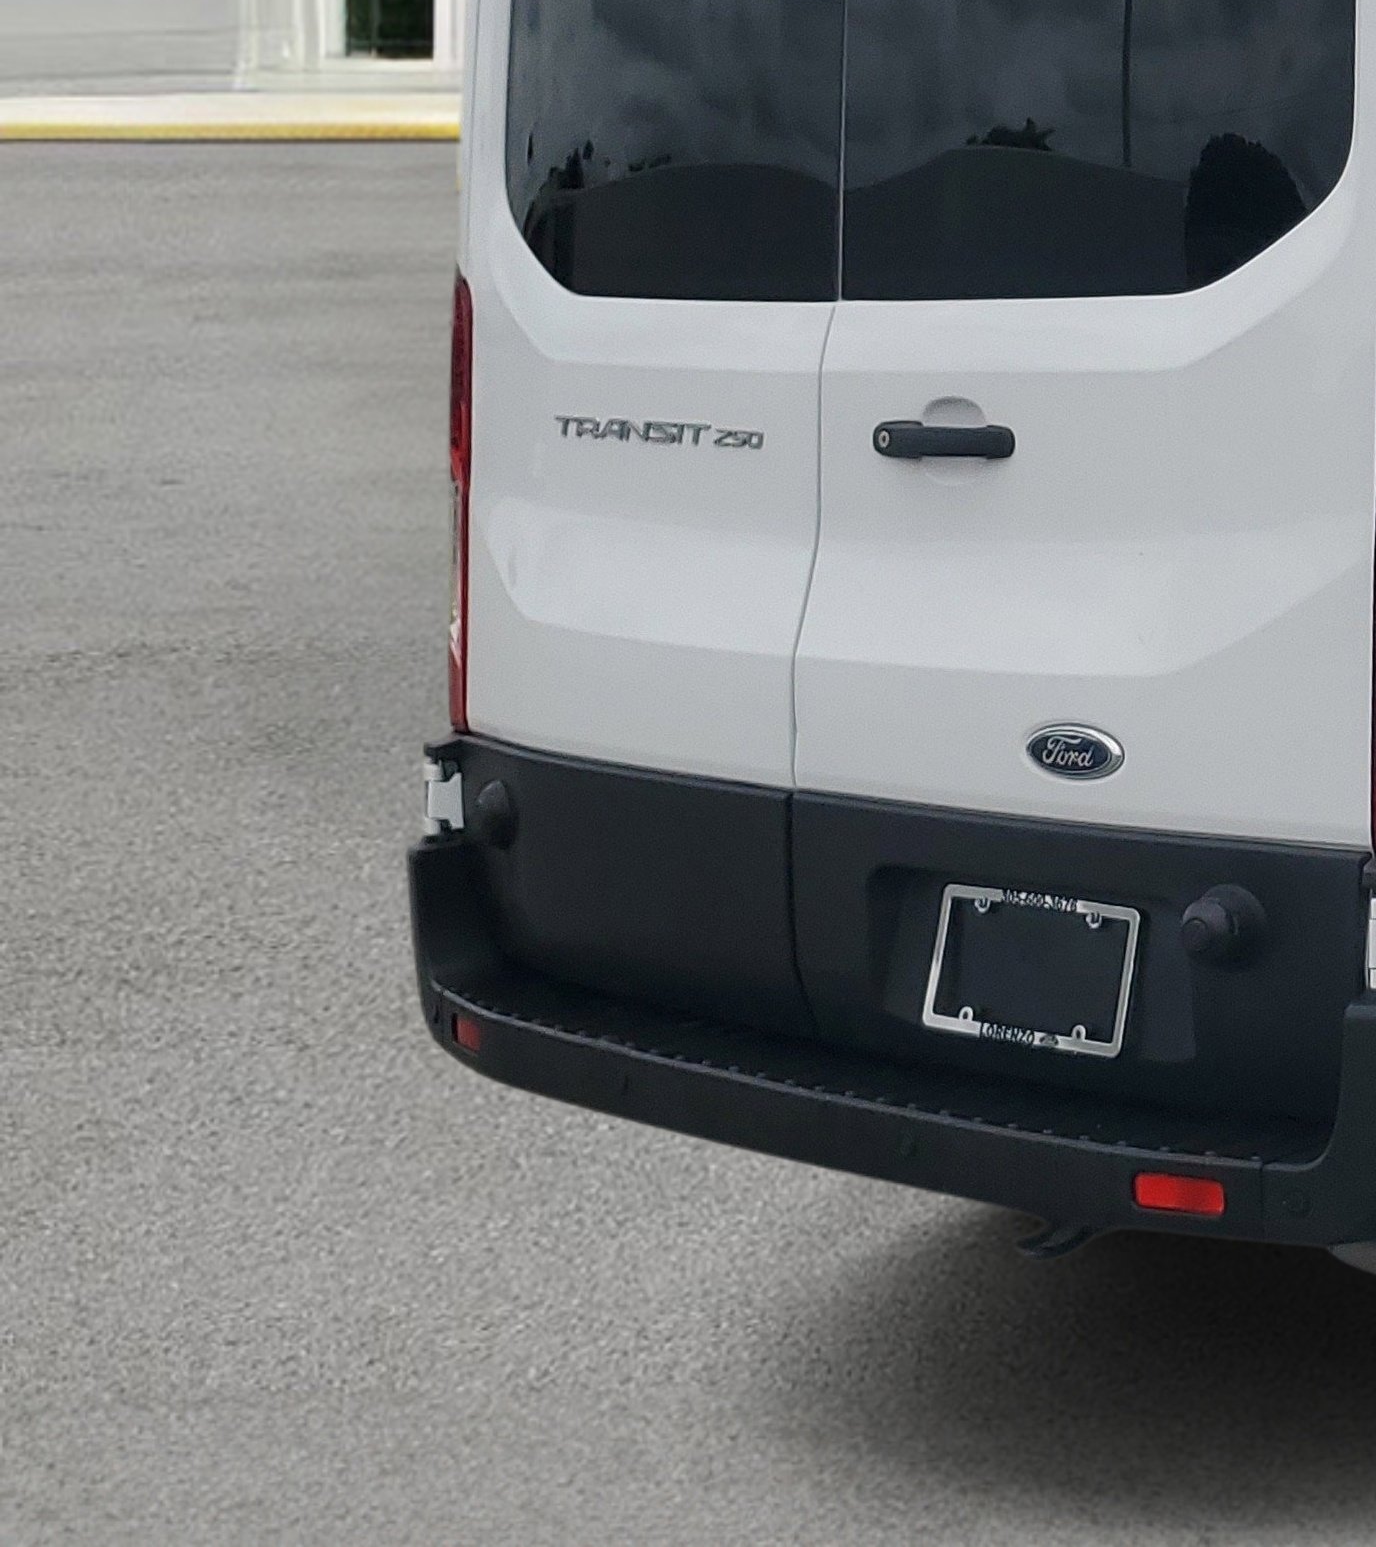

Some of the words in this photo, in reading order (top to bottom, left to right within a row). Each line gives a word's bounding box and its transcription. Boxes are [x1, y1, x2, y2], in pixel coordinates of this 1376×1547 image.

[555, 414, 712, 447] TRANSIT
[714, 426, 765, 451] 250
[1041, 735, 1095, 767] Ford
[980, 1021, 1035, 1045] LORENZO
